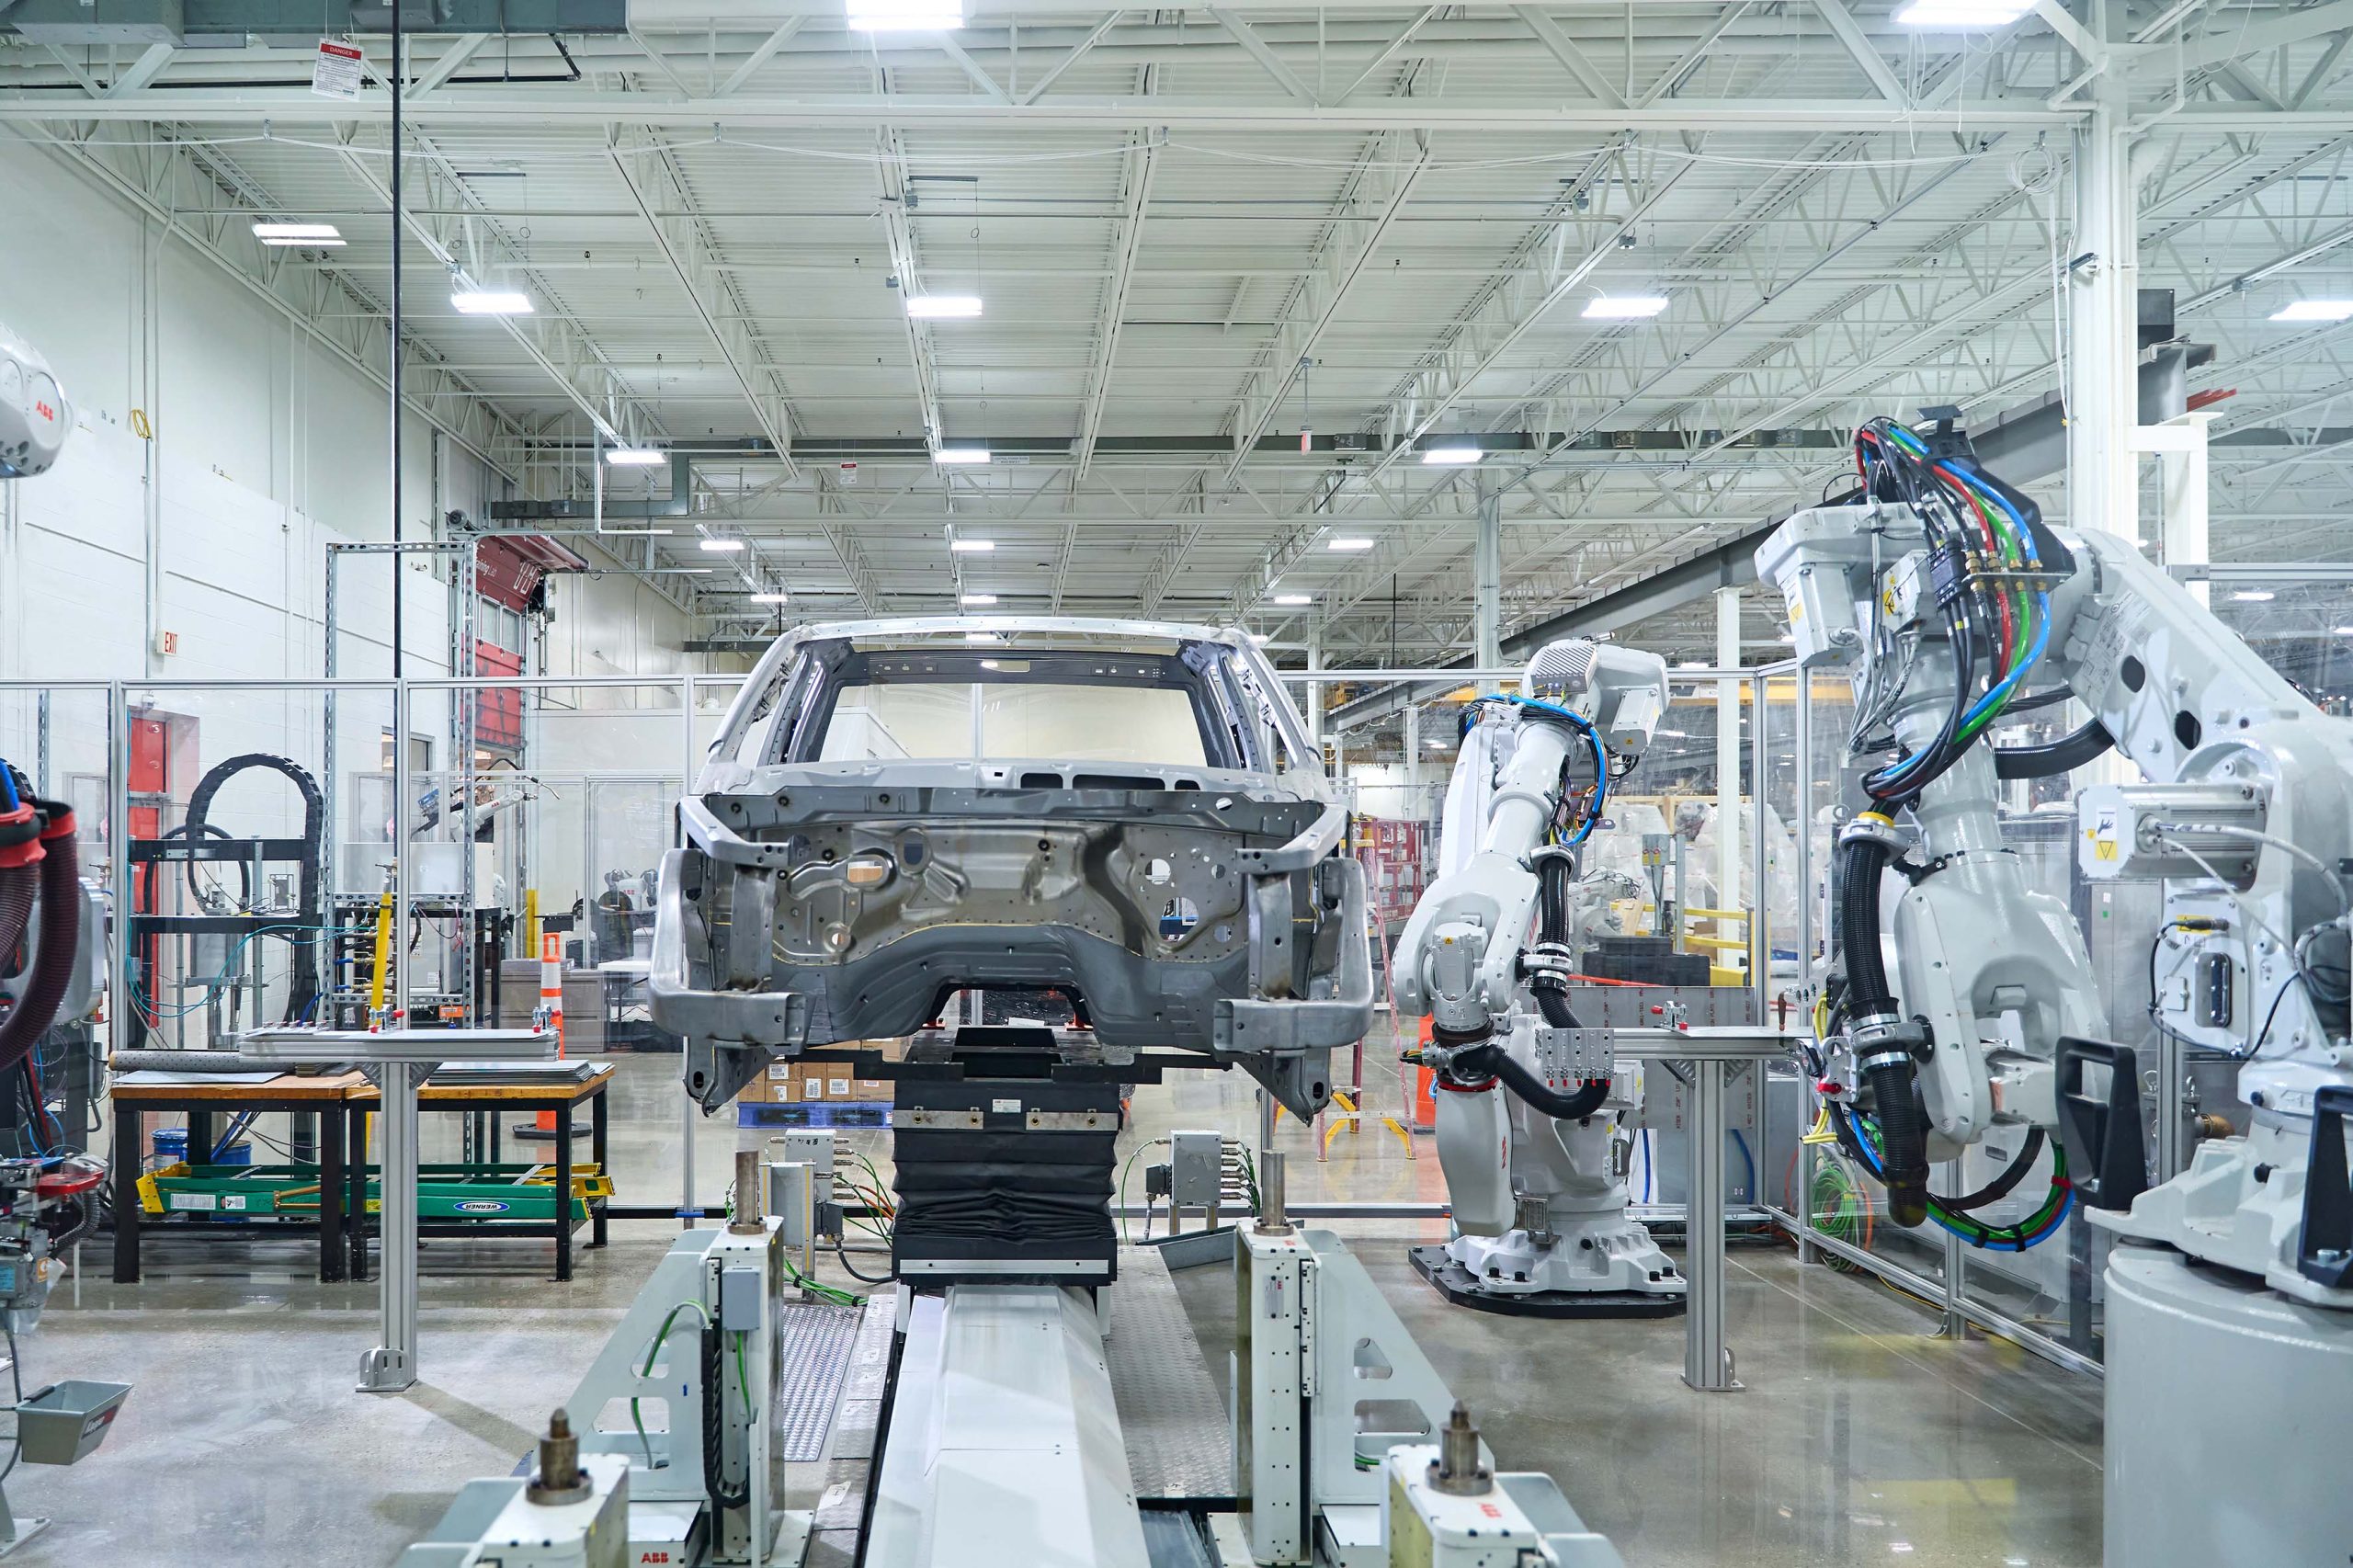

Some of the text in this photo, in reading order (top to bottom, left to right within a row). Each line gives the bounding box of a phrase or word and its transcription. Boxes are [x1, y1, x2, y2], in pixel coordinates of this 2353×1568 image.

[329, 47, 353, 57] DANGER
[35, 400, 53, 422] ABB
[165, 631, 177, 654] EXIT
[641, 1551, 669, 1563] ABB
